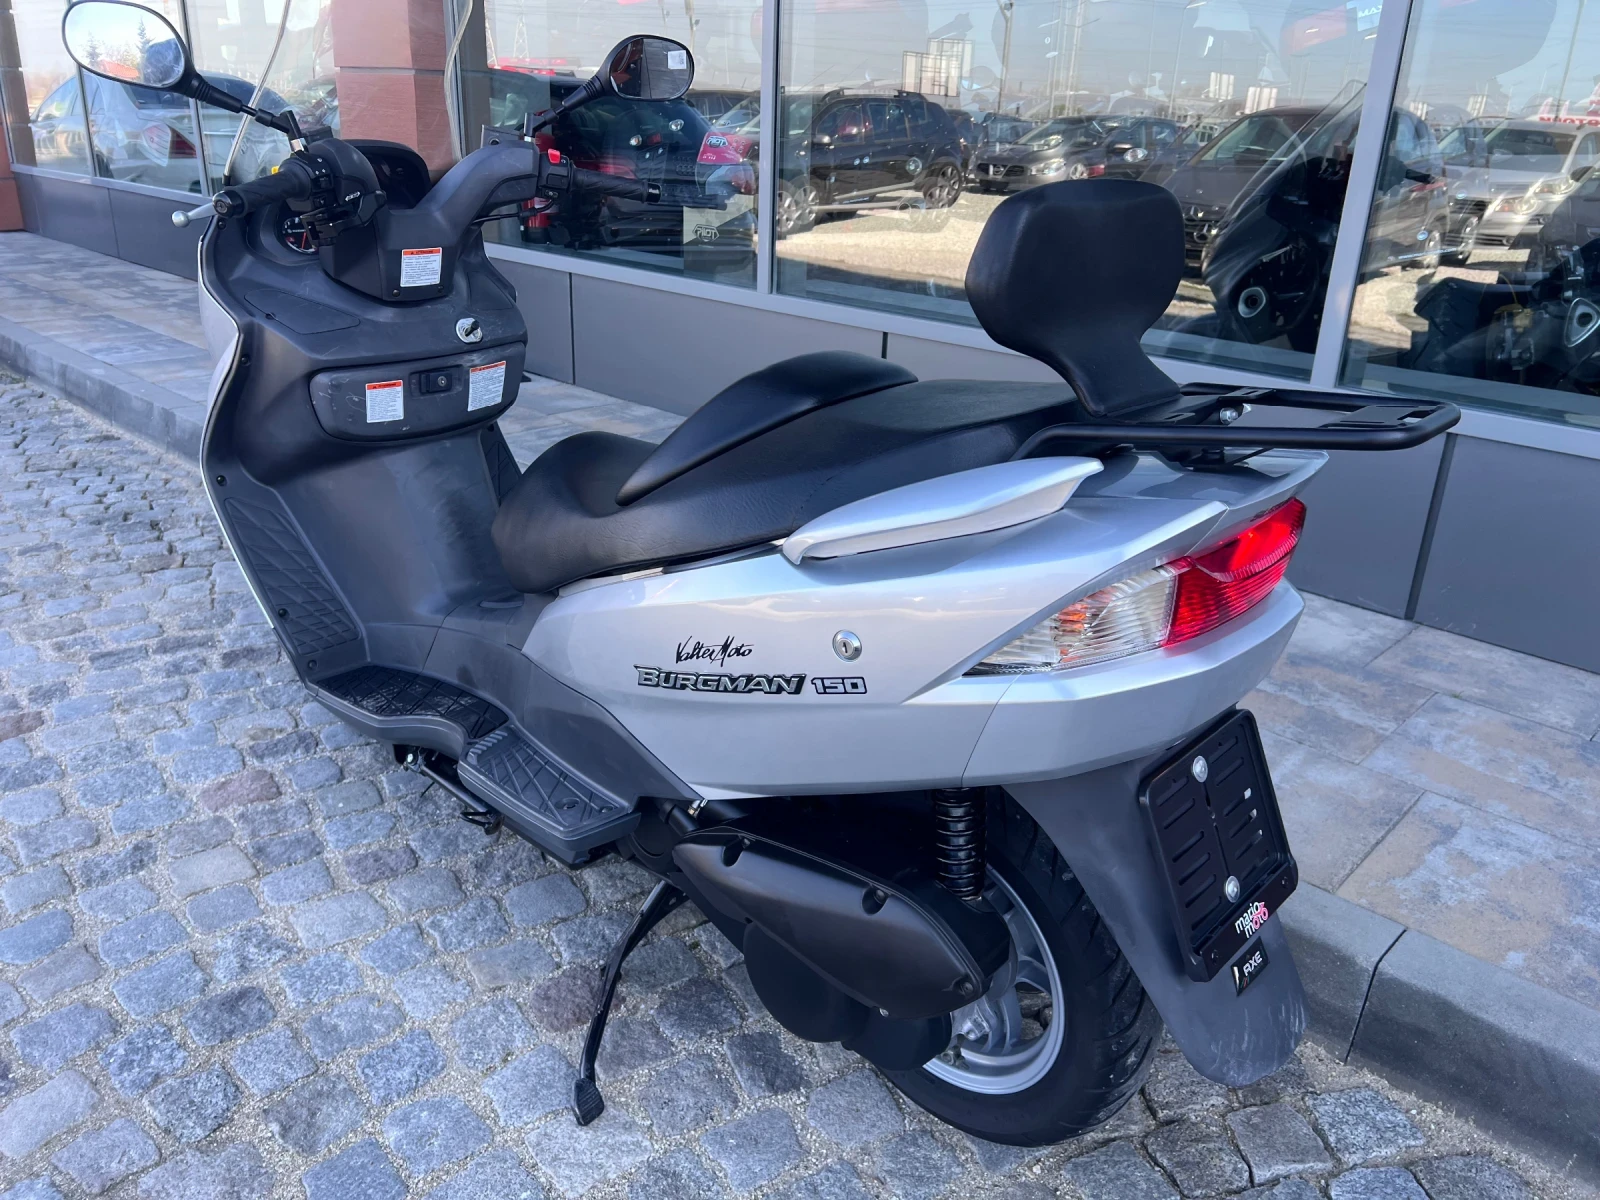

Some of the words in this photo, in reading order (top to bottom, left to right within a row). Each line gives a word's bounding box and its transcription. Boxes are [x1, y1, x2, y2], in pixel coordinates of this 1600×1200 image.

[634, 664, 806, 695] BURGMAN
[811, 676, 867, 694] 150
[1234, 902, 1261, 934] mario
[1244, 907, 1269, 939] moto
[1242, 950, 1263, 977] AXE
